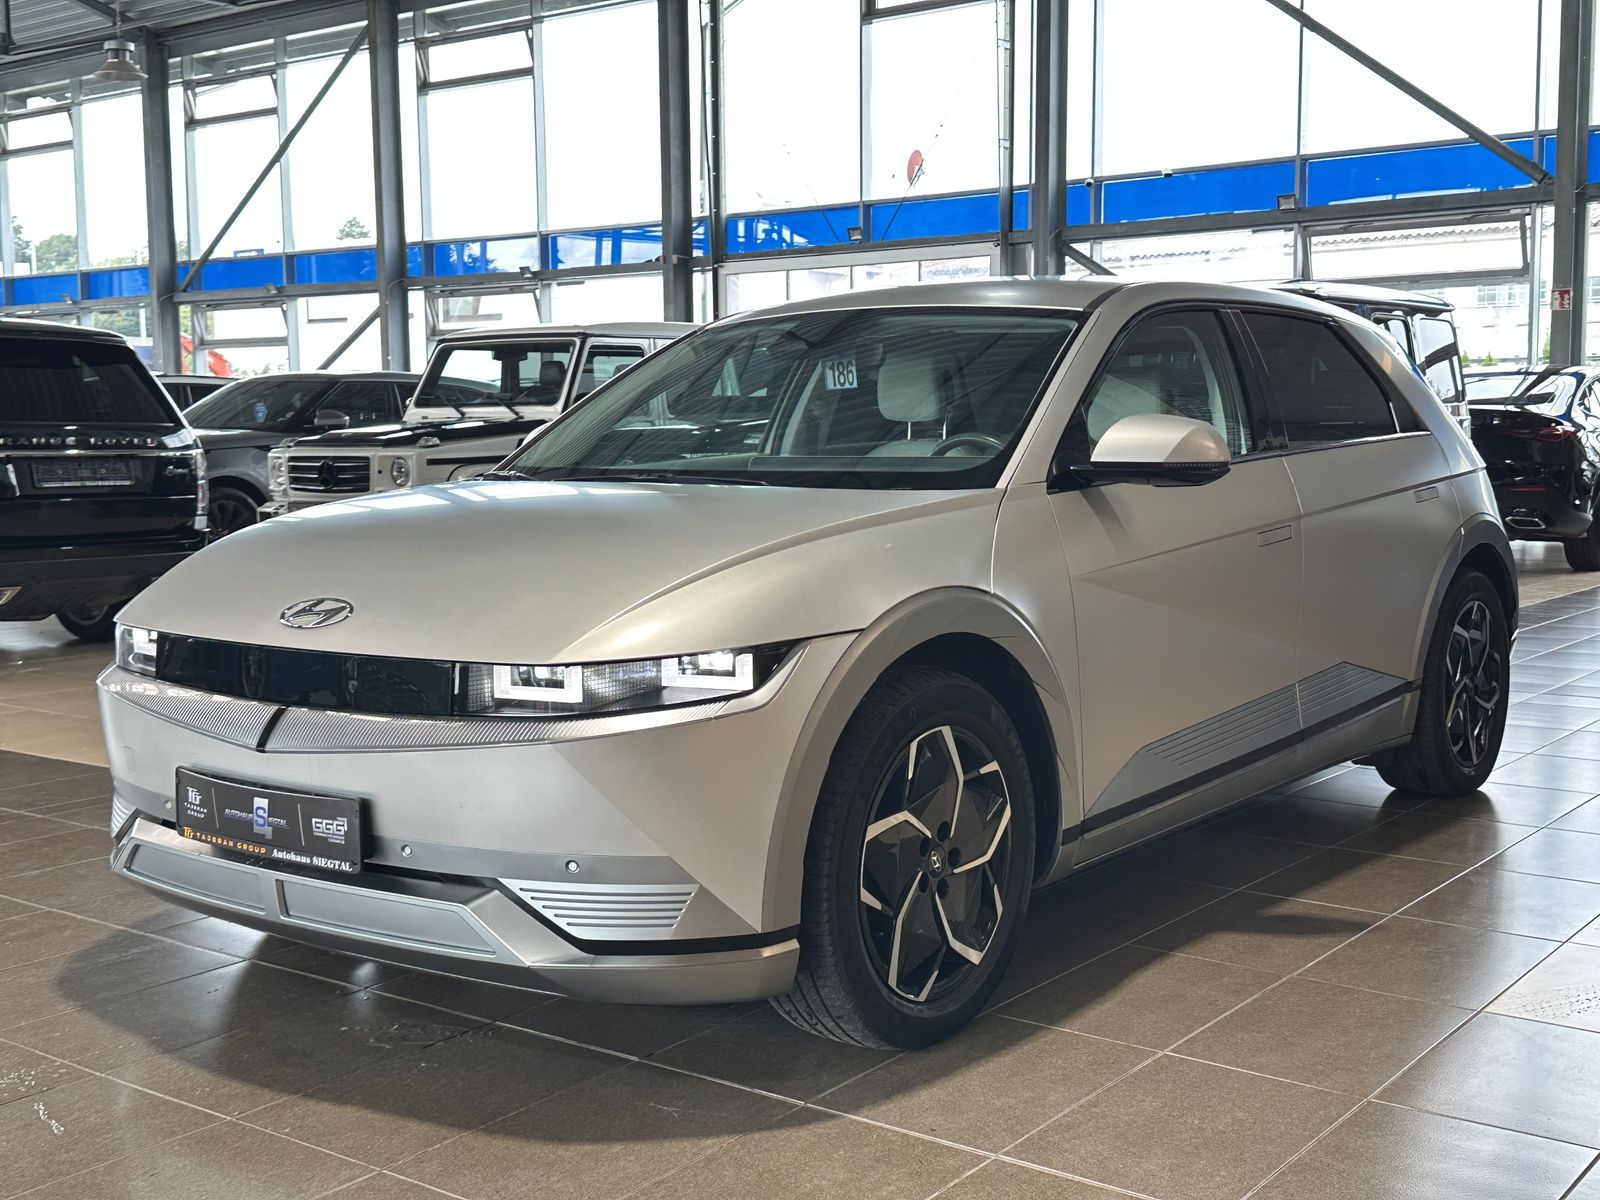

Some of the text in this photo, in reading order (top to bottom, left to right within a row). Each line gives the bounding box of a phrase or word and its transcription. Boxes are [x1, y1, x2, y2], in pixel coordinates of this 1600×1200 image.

[828, 361, 854, 387] 186
[237, 842, 266, 854] GROUP
[272, 848, 352, 872] Autohaus SIEGTAL
